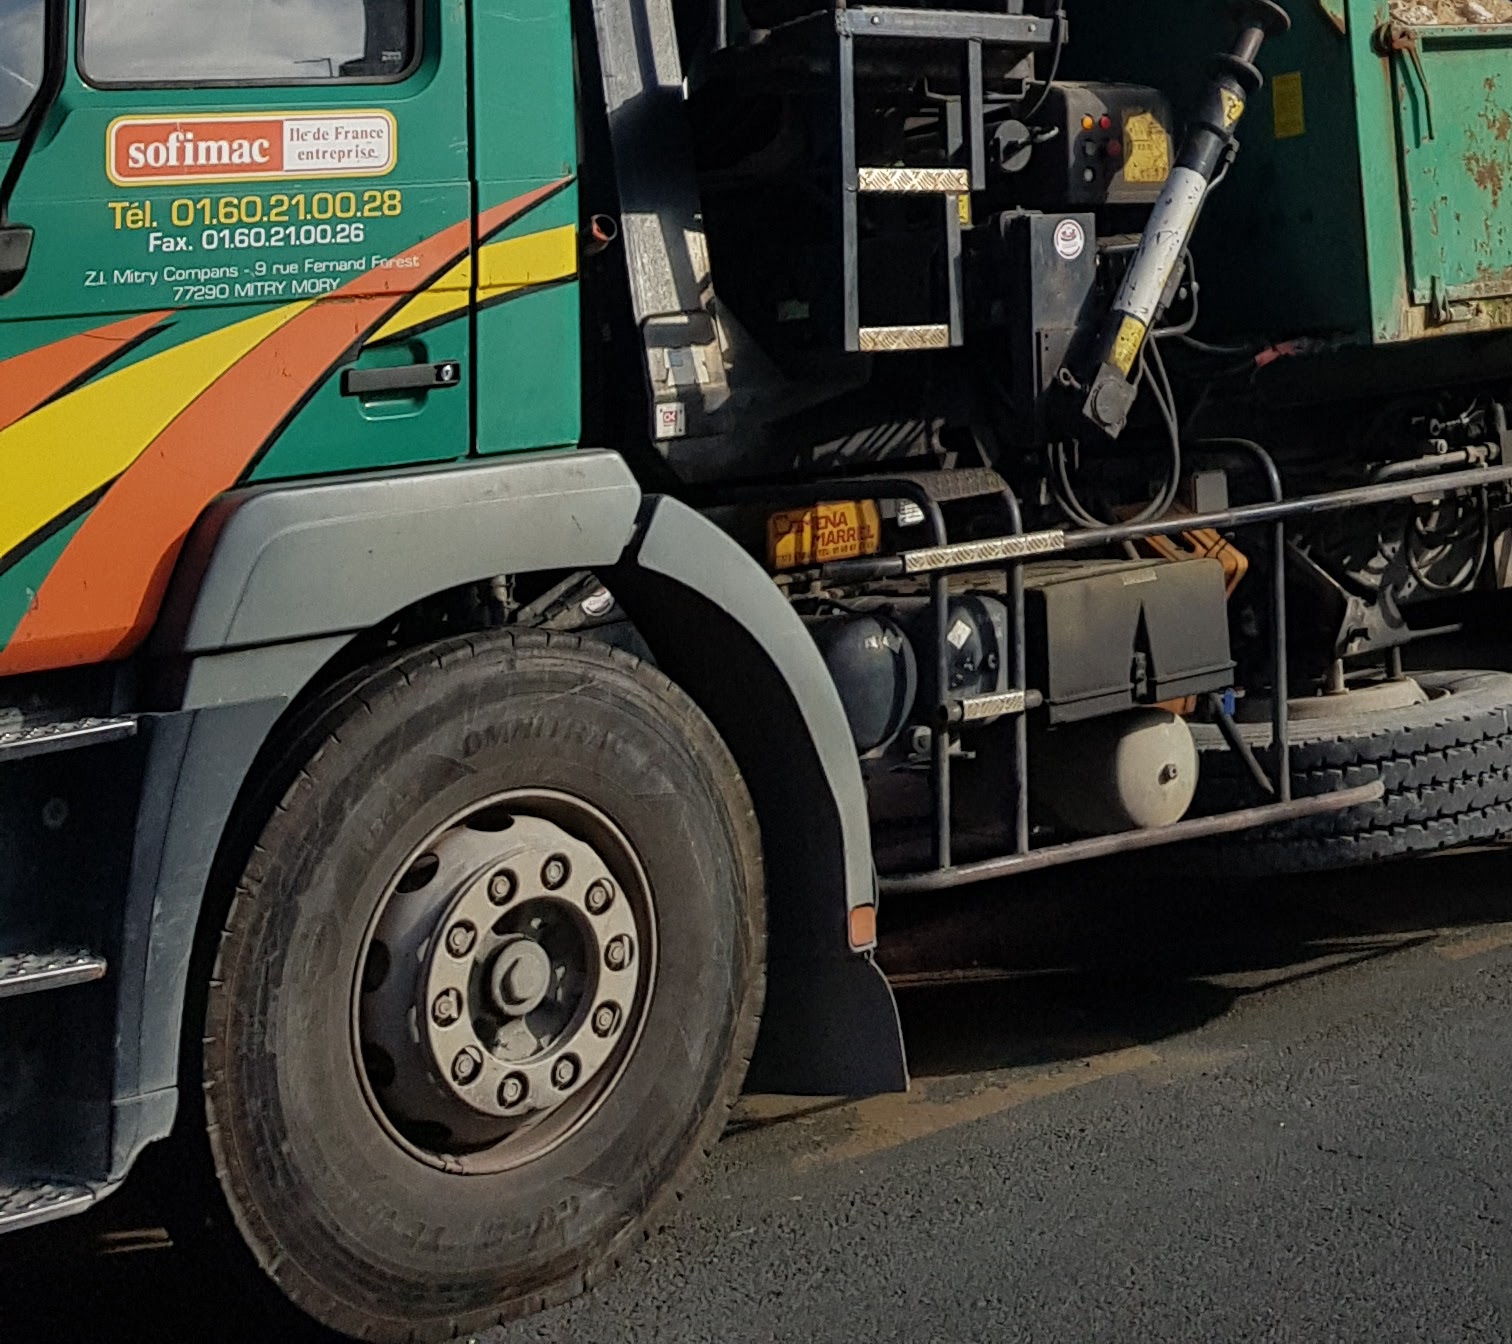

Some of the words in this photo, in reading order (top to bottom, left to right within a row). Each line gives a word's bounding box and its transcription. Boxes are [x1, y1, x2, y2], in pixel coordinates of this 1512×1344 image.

[312, 128, 330, 141] de
[334, 125, 384, 141] France
[127, 131, 271, 169] sofimac
[297, 144, 376, 163] entreprise
[107, 200, 158, 230] Tél.
[170, 189, 402, 227] 01.60.21.00.28
[148, 232, 193, 253] Fax.
[201, 222, 365, 250] 01.60.21.00.26
[113, 268, 159, 286] Mitry
[163, 265, 239, 283] Compans
[254, 260, 267, 276] 9
[272, 262, 299, 275] rue
[304, 256, 366, 274] Fernand
[371, 254, 420, 269] Forest
[172, 283, 230, 302] 77290
[234, 280, 287, 297] MITRY
[291, 277, 341, 294] MORY
